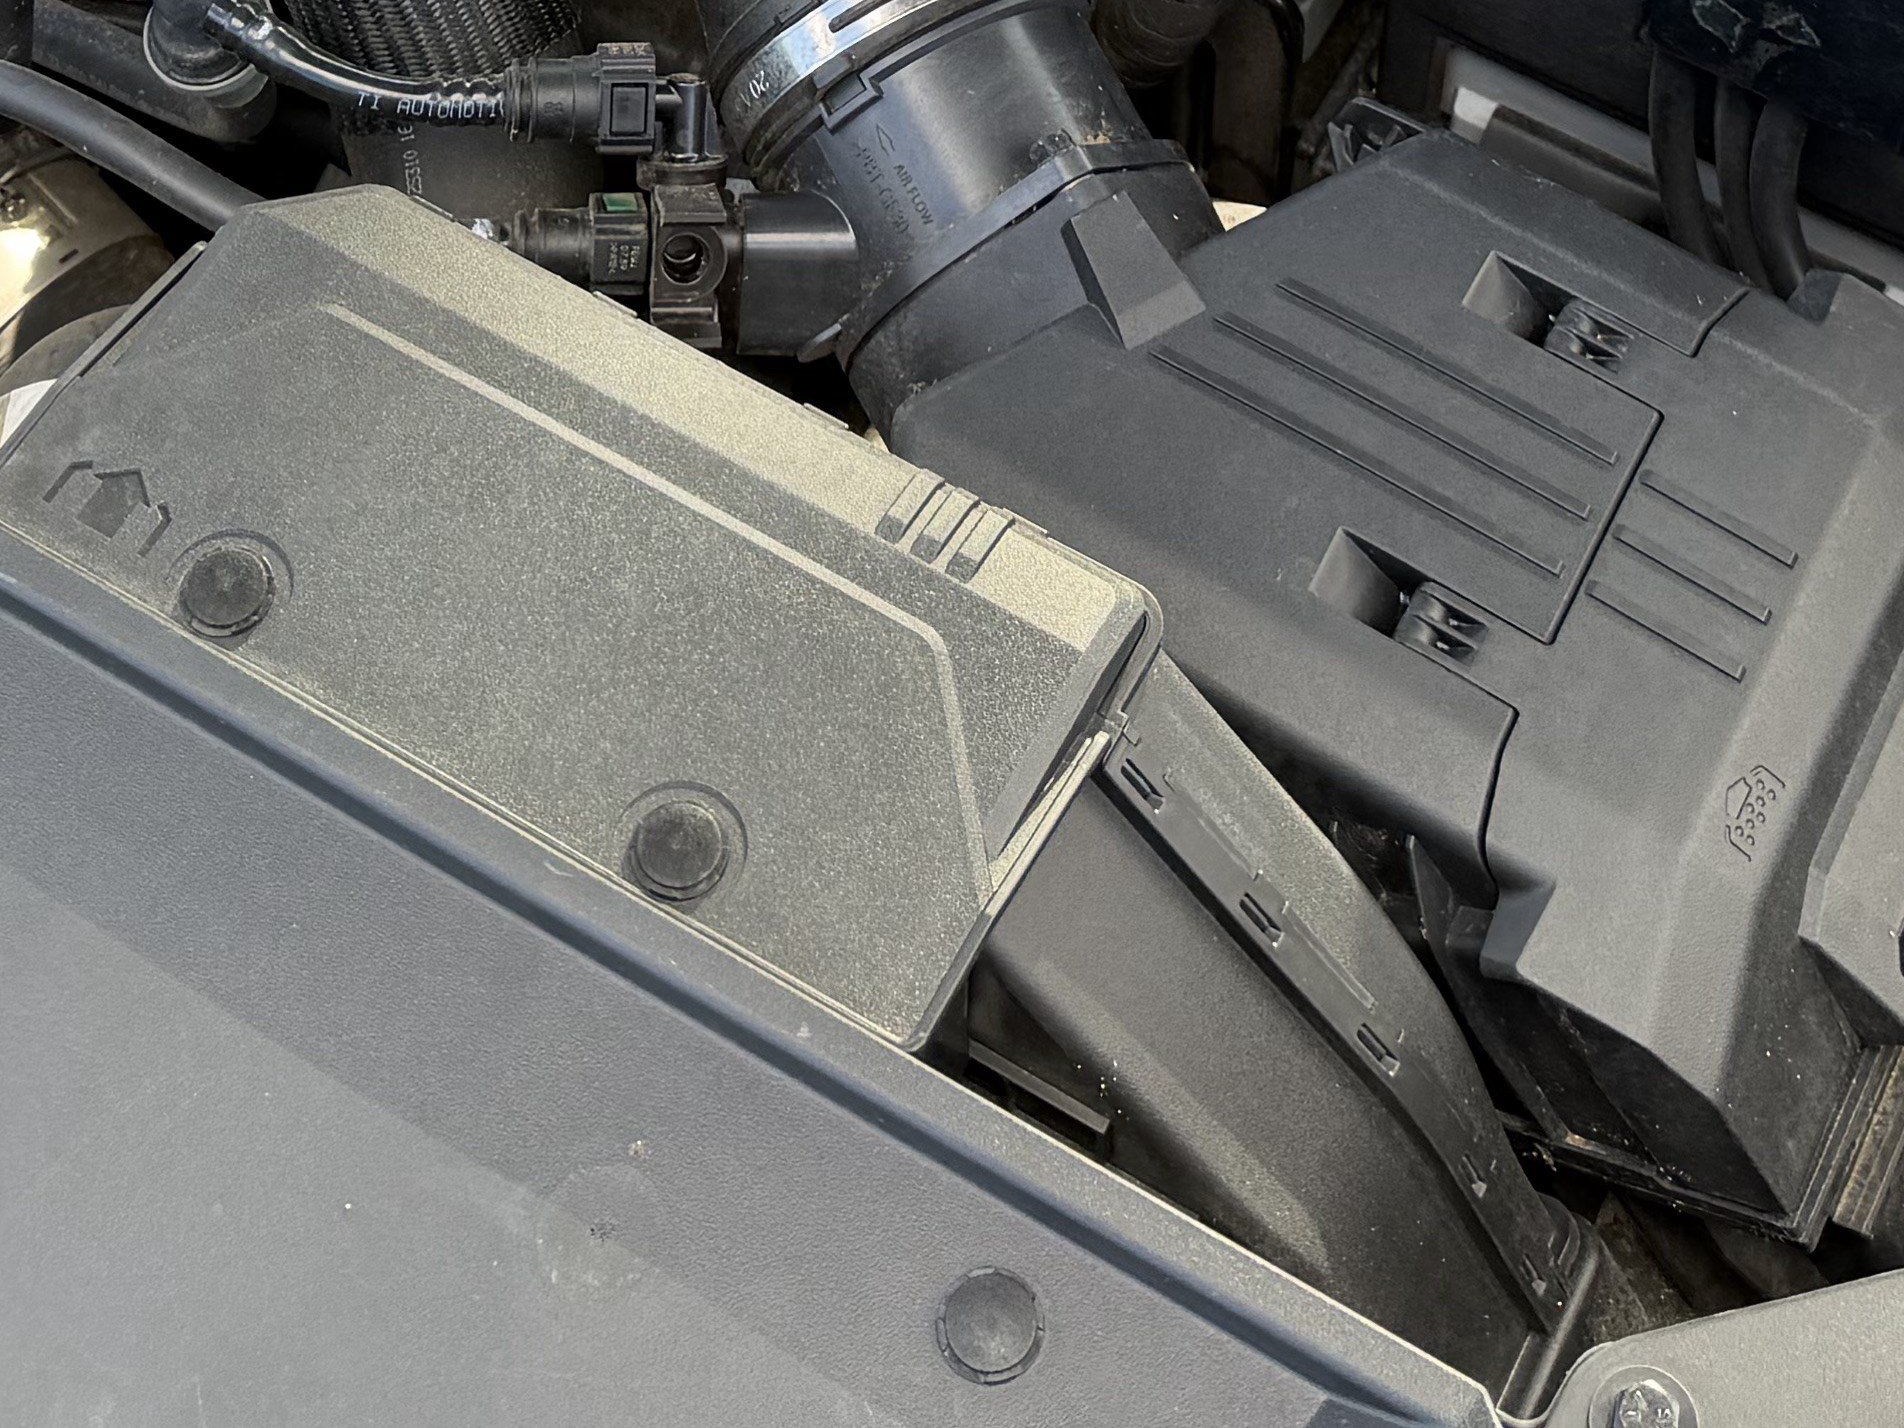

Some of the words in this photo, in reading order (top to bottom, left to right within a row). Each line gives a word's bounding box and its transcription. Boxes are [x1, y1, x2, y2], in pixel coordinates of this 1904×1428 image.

[357, 91, 379, 109] TI
[892, 161, 914, 188] AIR
[905, 185, 936, 227] FLOW
